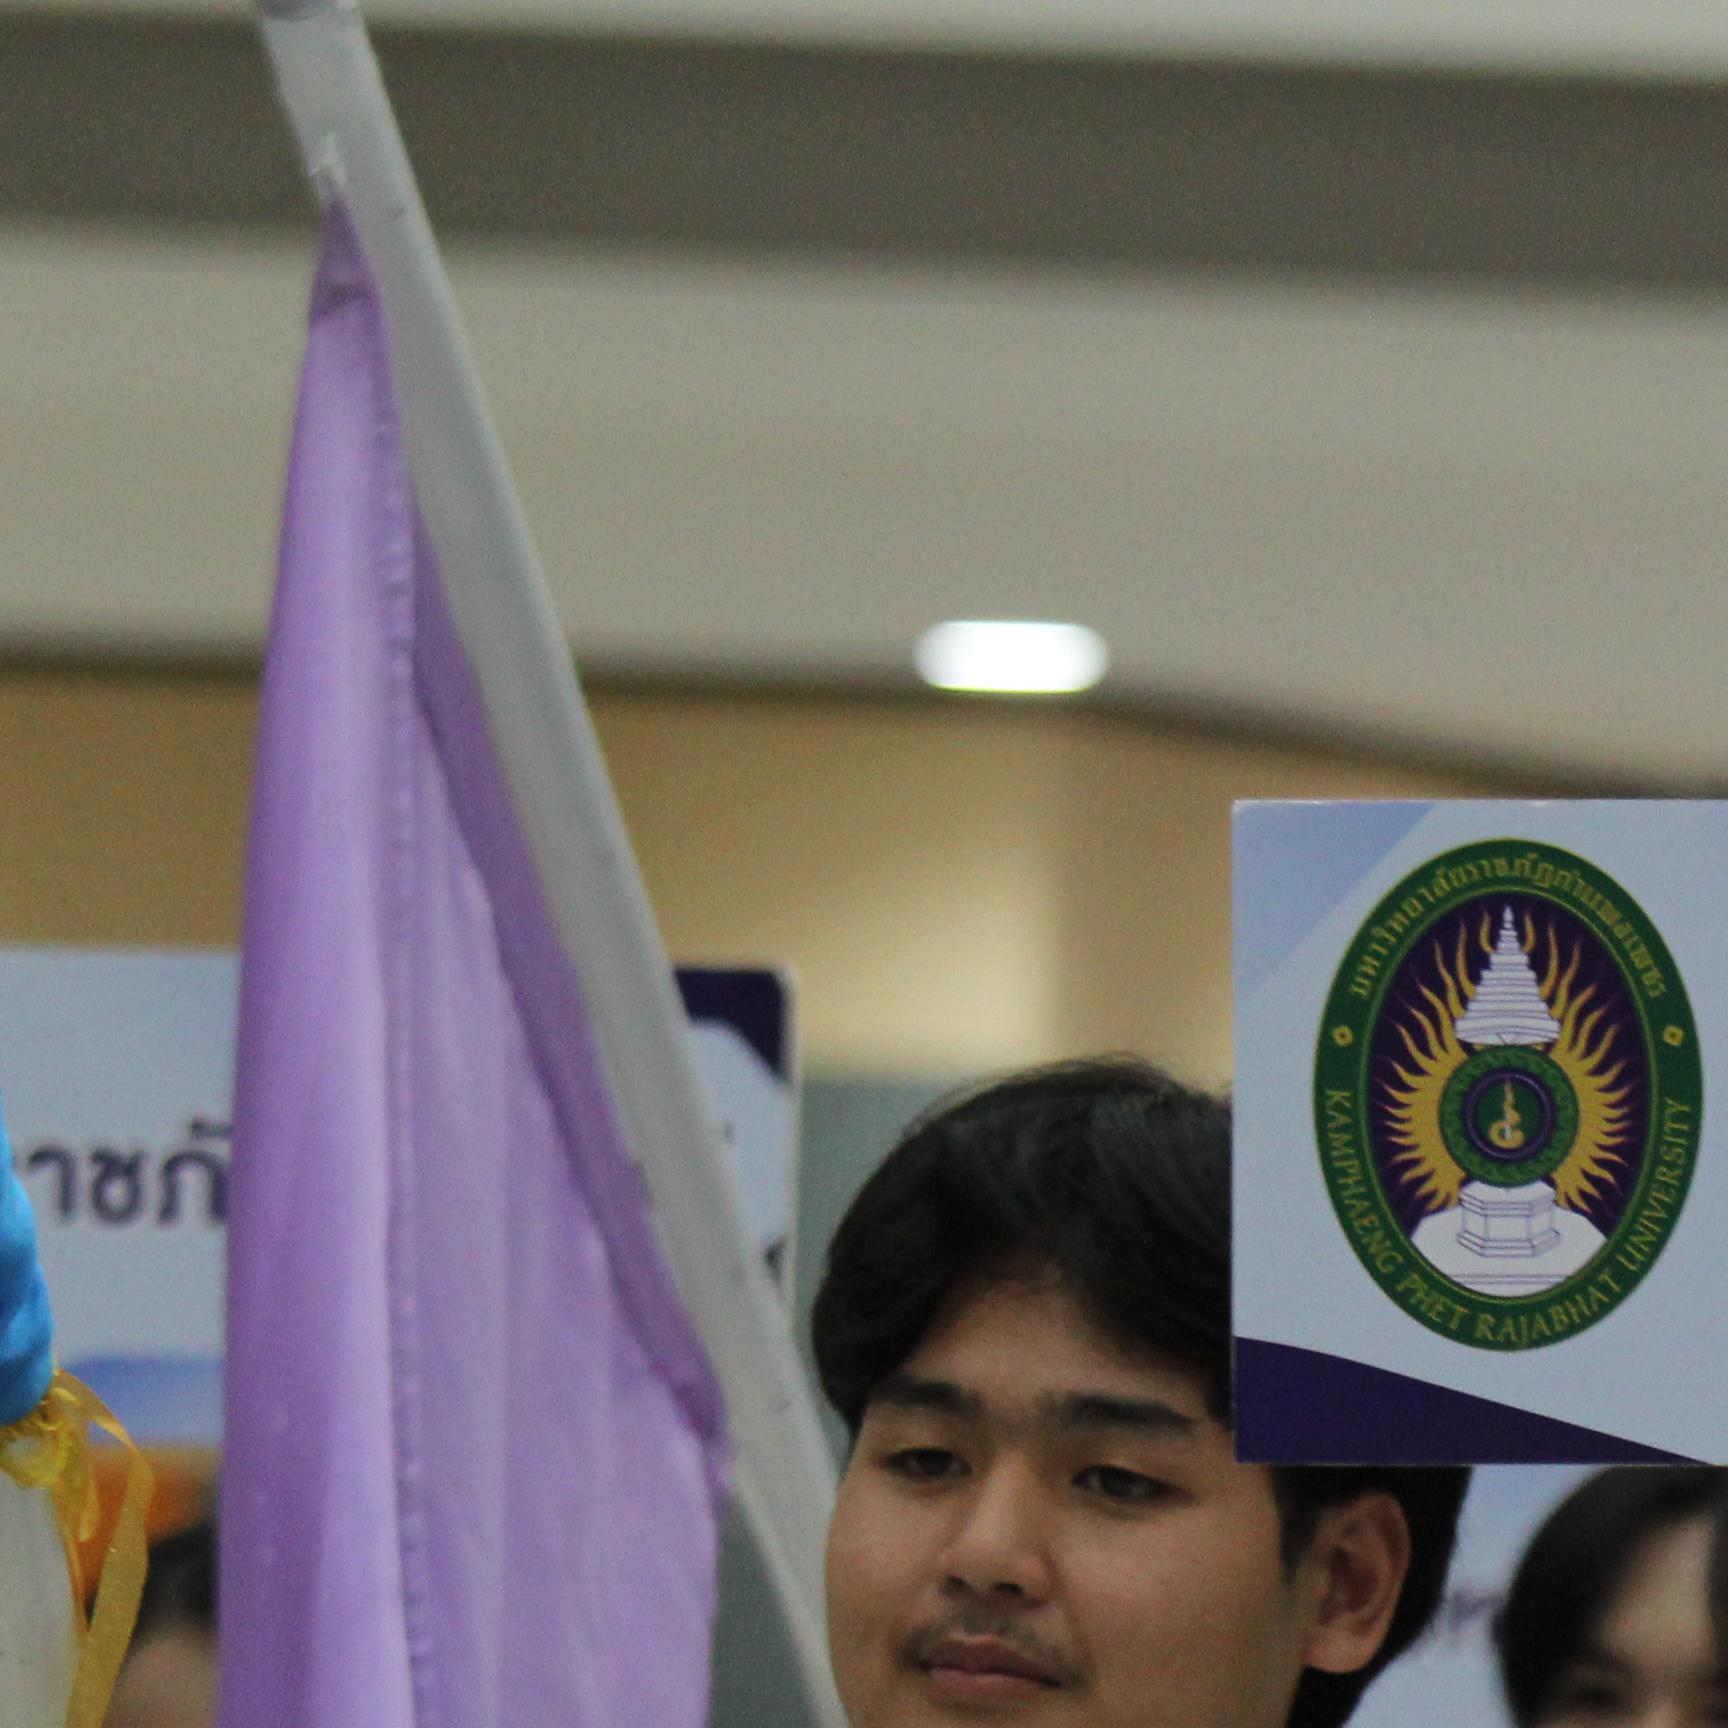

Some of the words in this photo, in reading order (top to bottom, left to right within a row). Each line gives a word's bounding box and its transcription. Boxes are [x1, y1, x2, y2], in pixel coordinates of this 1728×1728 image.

[1325, 1090, 1404, 1275] KAMPHAENG
[1397, 1271, 1470, 1331] PHET
[1474, 1267, 1621, 1346] RAJABHAT
[1615, 1097, 1692, 1273] UNIVERSITY
